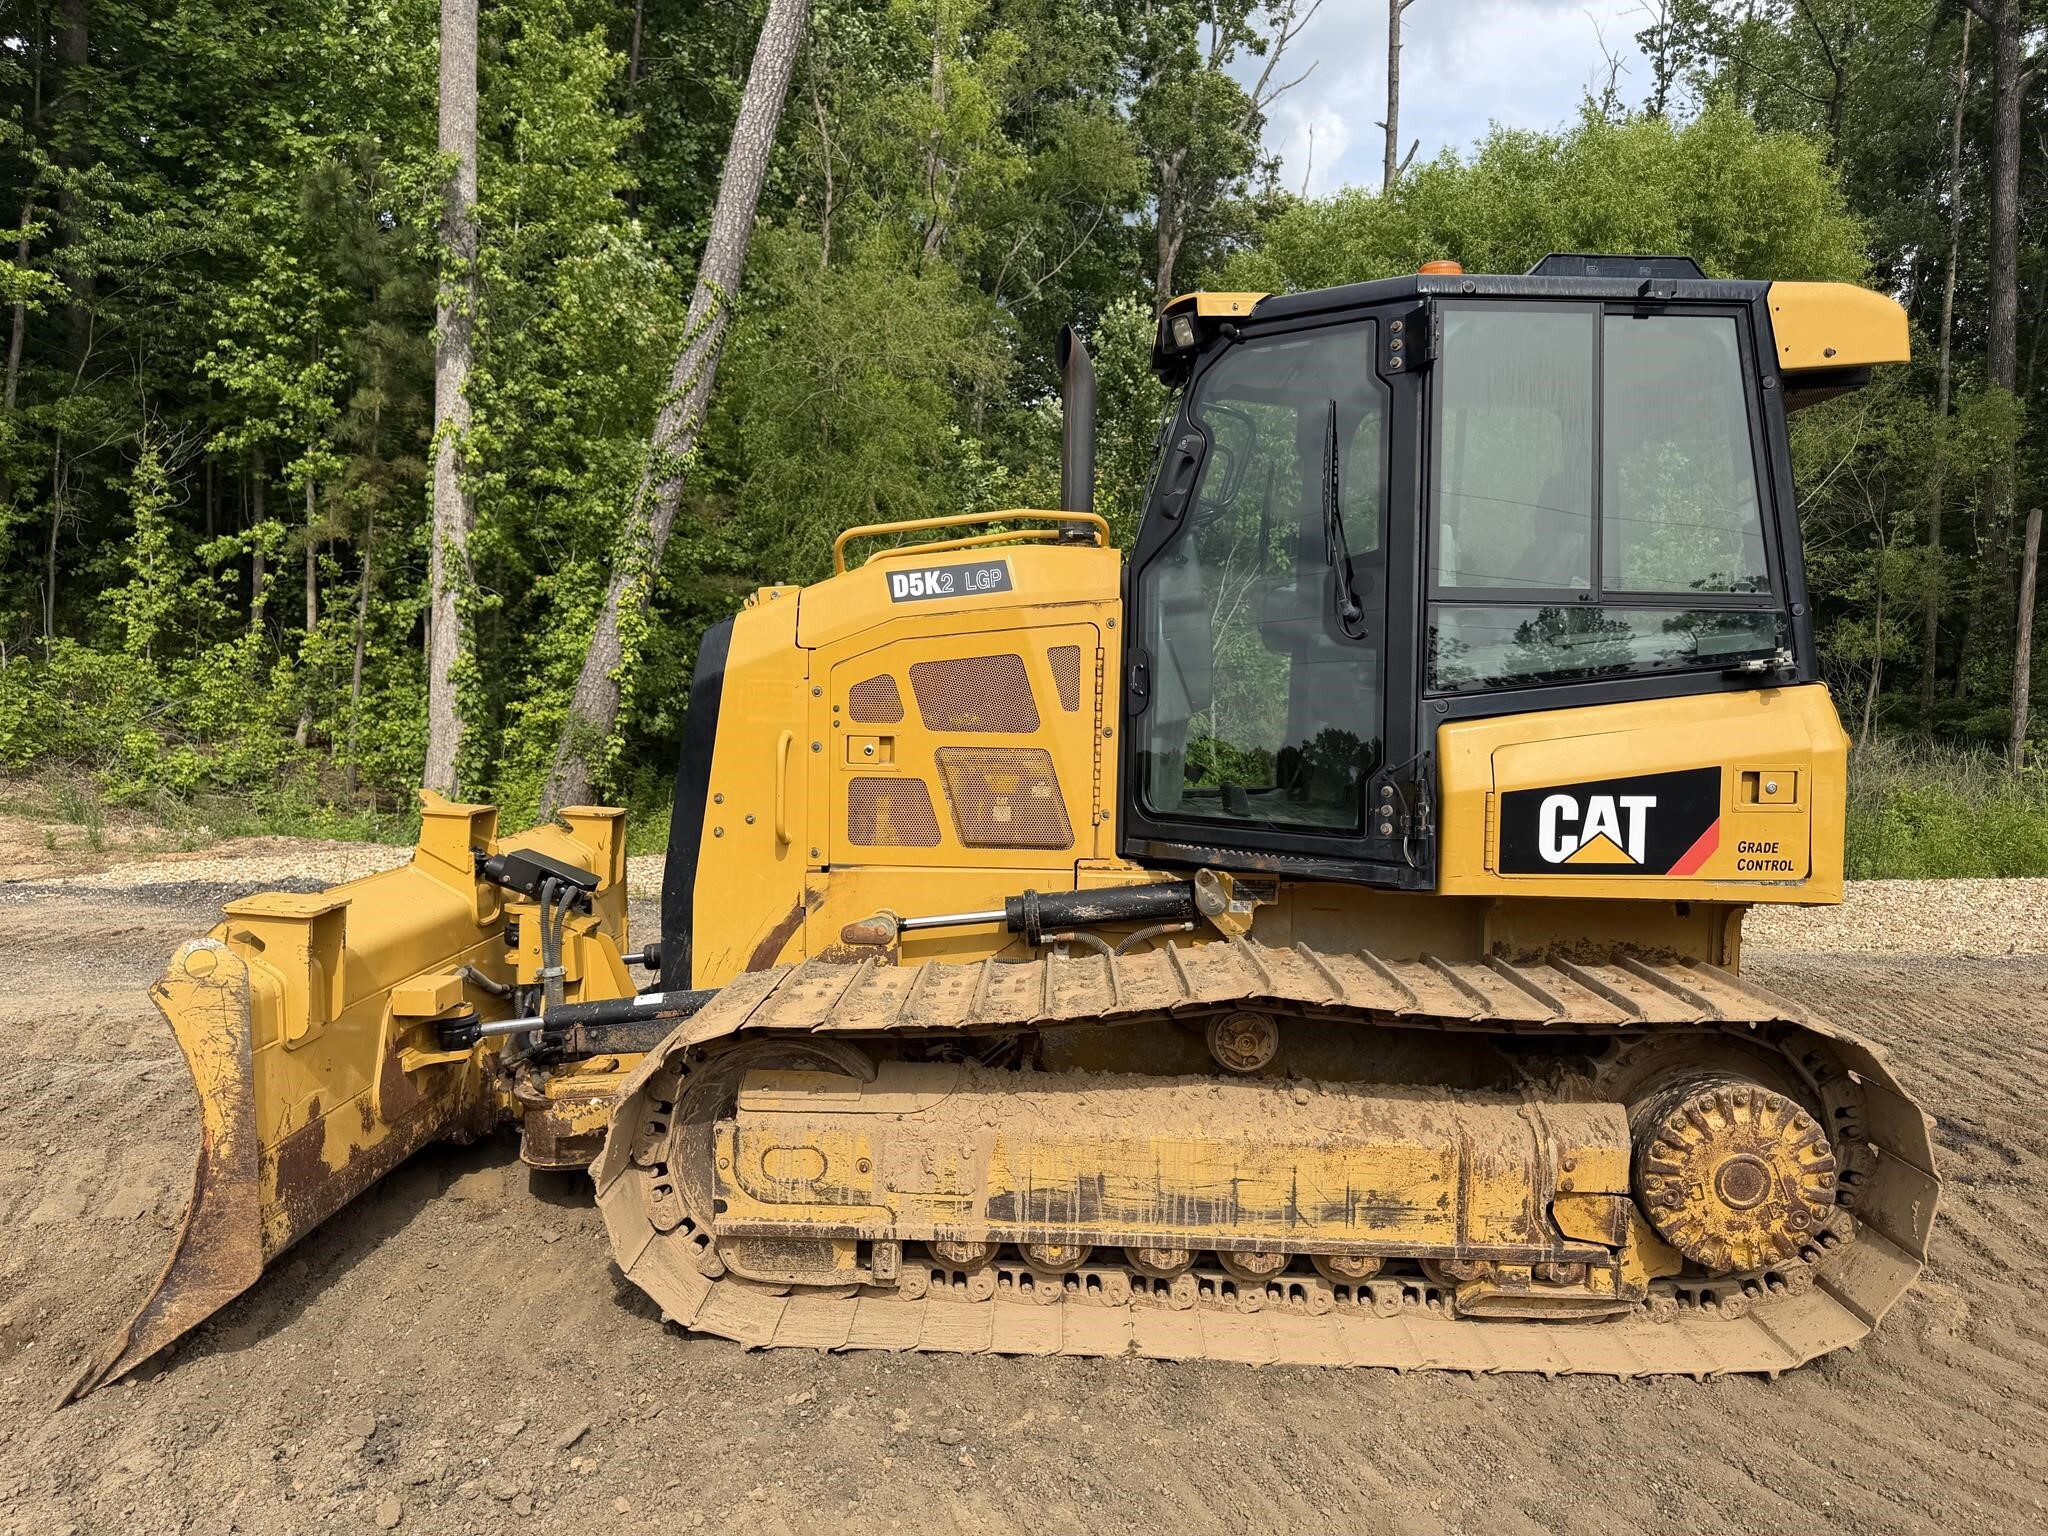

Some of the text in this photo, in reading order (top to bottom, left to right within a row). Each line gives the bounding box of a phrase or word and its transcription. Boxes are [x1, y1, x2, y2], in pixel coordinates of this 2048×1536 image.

[892, 569, 1002, 598] D5K2 LGP
[1538, 794, 1657, 864] CAT
[1737, 841, 1779, 853] GRADE
[1737, 859, 1794, 871] CONTROL
